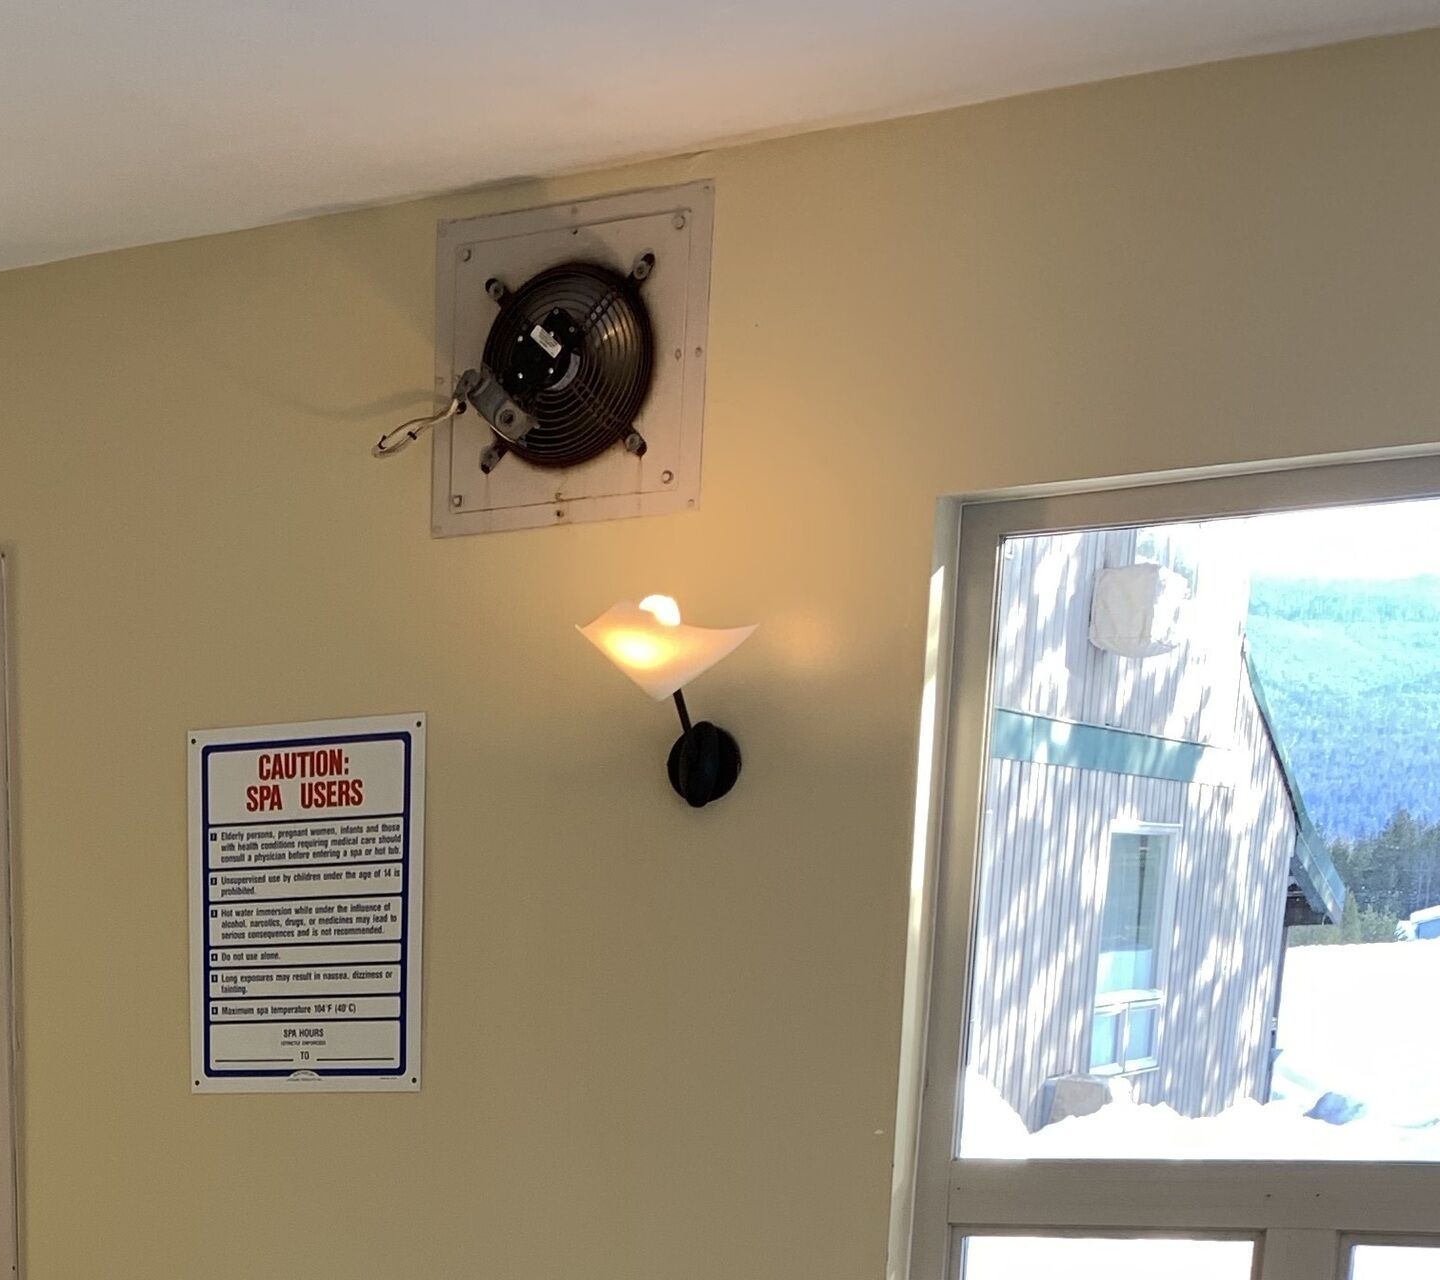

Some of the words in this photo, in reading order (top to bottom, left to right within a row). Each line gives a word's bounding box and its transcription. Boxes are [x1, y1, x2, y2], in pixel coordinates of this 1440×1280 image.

[259, 749, 349, 780] CAUTION:
[246, 785, 282, 812] SPA
[301, 779, 363, 809] USERS
[221, 831, 244, 843] Elderly
[278, 829, 308, 839] pregnant
[340, 825, 363, 834] infants
[366, 824, 378, 832] and
[381, 823, 400, 832] those
[221, 843, 235, 851] with
[238, 842, 258, 851] health
[261, 840, 295, 850] conditions
[297, 838, 329, 849] requiring
[331, 836, 358, 845] medical
[361, 836, 376, 844] care
[379, 834, 401, 843] should
[254, 852, 286, 863] physician
[288, 851, 310, 860] before
[312, 849, 340, 860] entering
[350, 849, 362, 858] spa
[375, 846, 386, 855] hot
[221, 875, 266, 884] Unsupervised
[294, 872, 321, 882] children
[323, 871, 343, 880] under
[346, 870, 356, 879] the
[359, 870, 371, 880] age
[221, 908, 232, 917] Hot
[235, 909, 253, 917] water
[256, 906, 292, 916] immersion
[295, 905, 313, 914] while
[315, 904, 334, 913] under
[337, 904, 347, 912] the
[350, 903, 382, 912] influence
[319, 915, 353, 925] medicines
[356, 916, 370, 925] may
[373, 914, 388, 923] lead
[221, 930, 245, 940] serious
[248, 929, 294, 940] consequences
[297, 928, 309, 937] and
[321, 927, 331, 936] not
[334, 925, 384, 936] recommended.
[221, 952, 231, 961] Do
[233, 952, 243, 960] not
[246, 952, 258, 960] use
[260, 951, 281, 960] alone.
[221, 974, 238, 983] Long
[240, 972, 273, 984] exposures
[276, 972, 290, 982] may
[293, 970, 311, 980] result
[352, 969, 383, 978] dizziness
[221, 1005, 254, 1015] Maximum
[257, 1006, 269, 1016] spa
[271, 1004, 311, 1015] temperature
[283, 1028, 297, 1038] SPA
[299, 1028, 324, 1038] HOURS
[300, 1051, 309, 1060] TO
